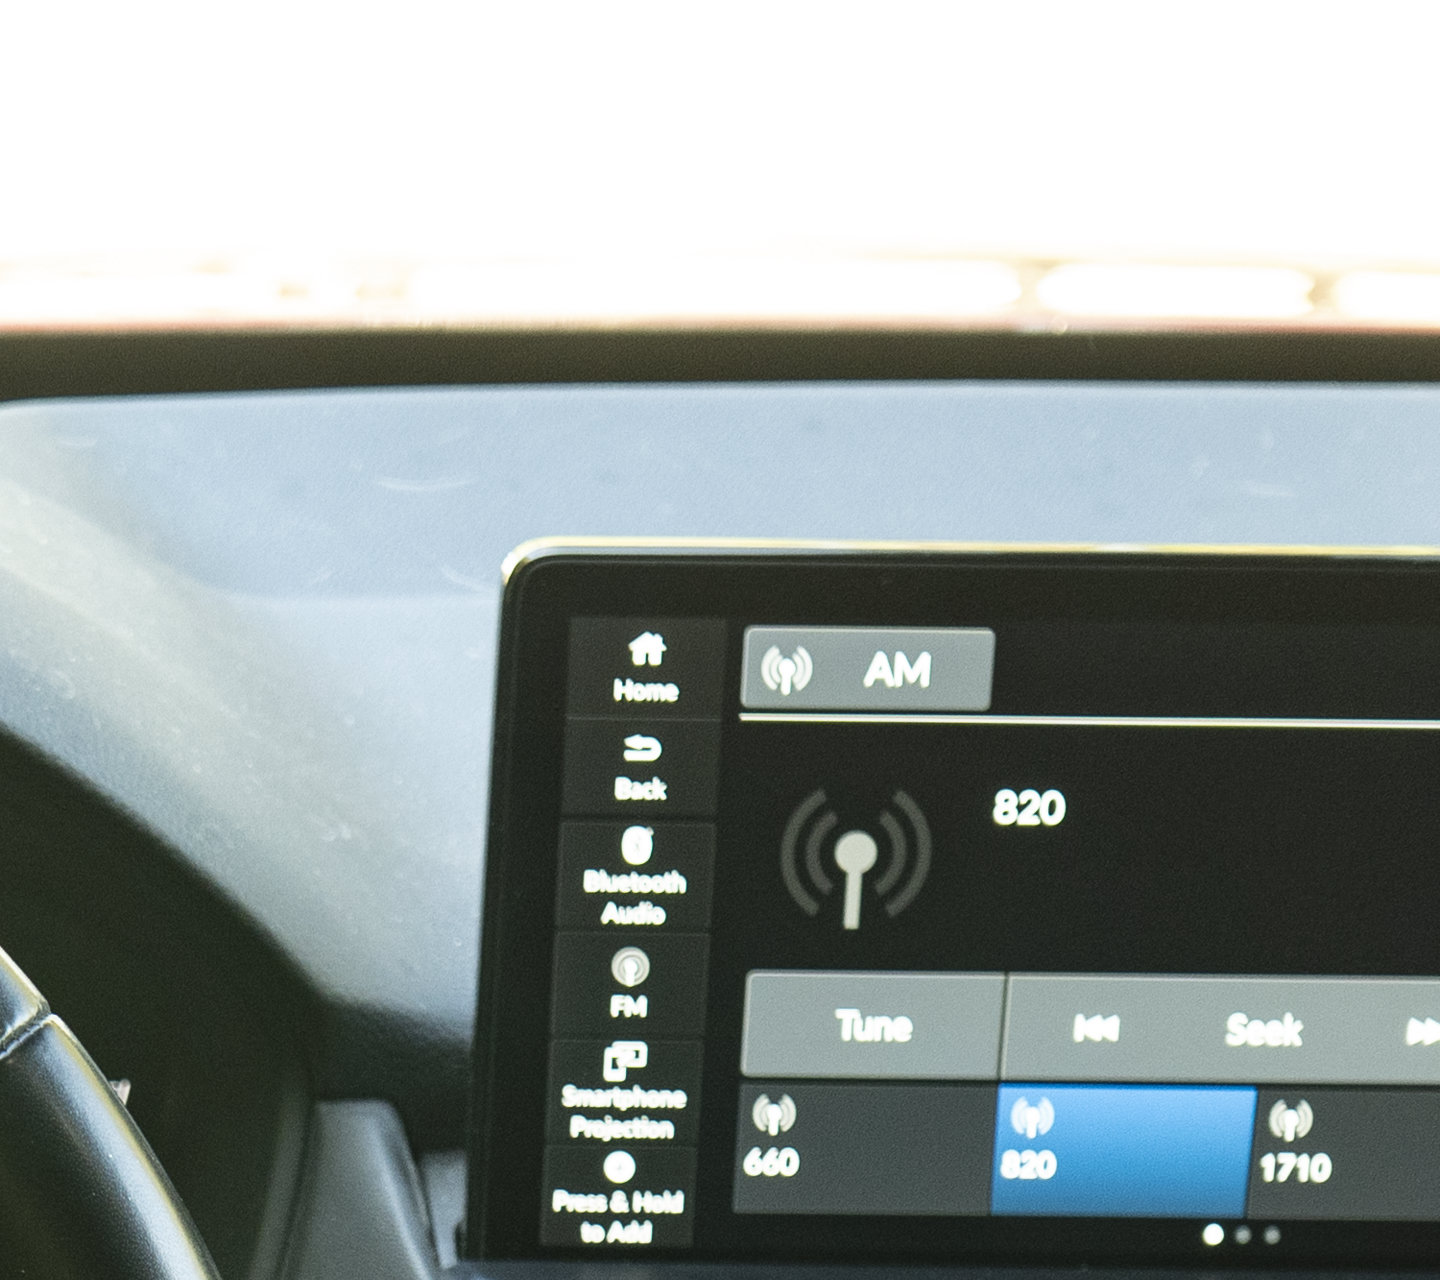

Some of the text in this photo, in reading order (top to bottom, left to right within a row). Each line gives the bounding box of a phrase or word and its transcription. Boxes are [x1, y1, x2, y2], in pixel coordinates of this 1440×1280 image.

[863, 651, 932, 688] AM
[612, 678, 680, 703] Home
[614, 776, 668, 801] Back
[992, 788, 1067, 827] 820
[582, 868, 688, 894] Bluetooth
[600, 900, 667, 926] Audio
[609, 994, 649, 1018] FM
[835, 1008, 913, 1043] Tune
[1225, 1012, 1304, 1047] Seek
[561, 1083, 688, 1112] Smartphone
[569, 1113, 675, 1143] Projection
[742, 1146, 800, 1177] 660
[999, 1147, 1059, 1181] 820
[1260, 1151, 1333, 1184] 1710
[551, 1188, 685, 1215] Press & Hold
[579, 1220, 653, 1245] to Add
